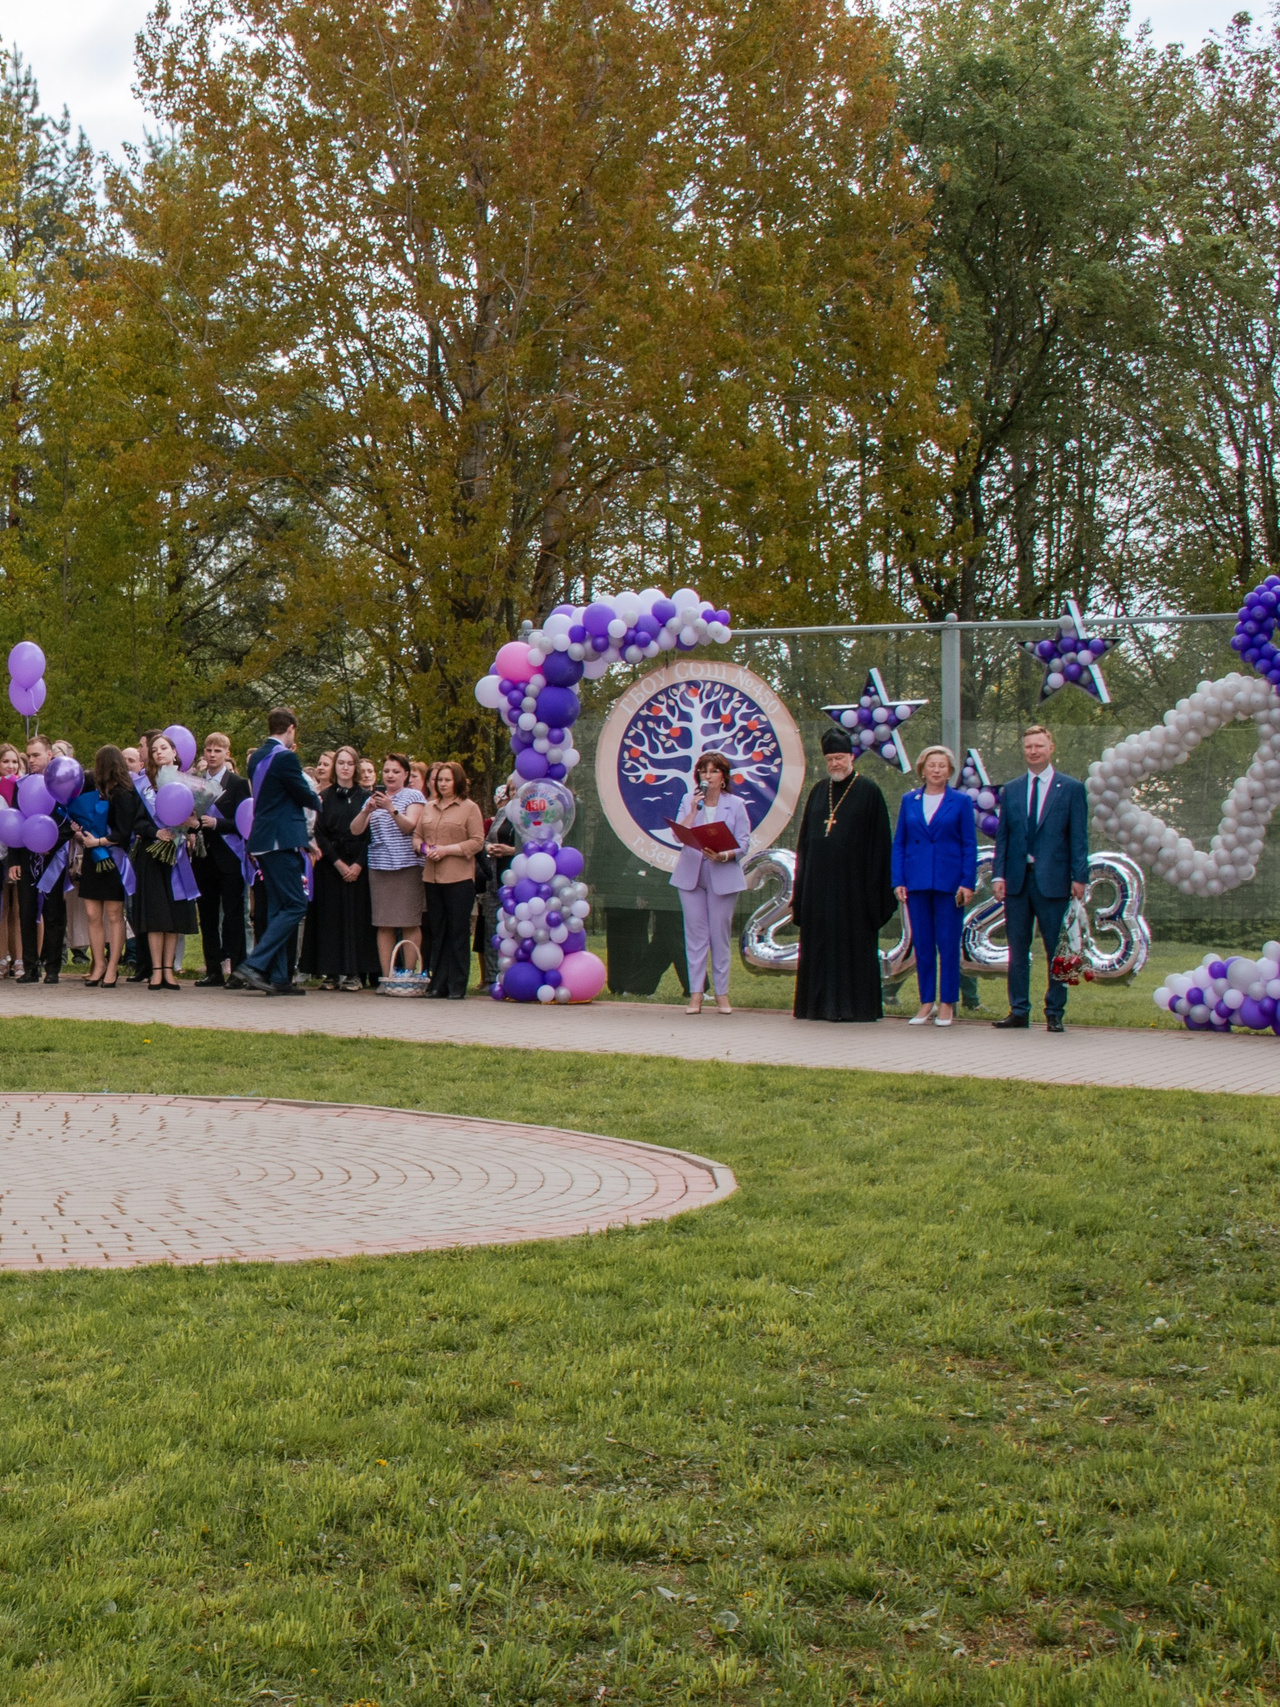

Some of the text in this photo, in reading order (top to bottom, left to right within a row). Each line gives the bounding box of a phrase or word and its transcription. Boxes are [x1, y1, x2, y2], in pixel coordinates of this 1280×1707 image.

[619, 667, 667, 716] ГБОУ
[674, 661, 728, 681] СОШ
[525, 799, 547, 812] 450
